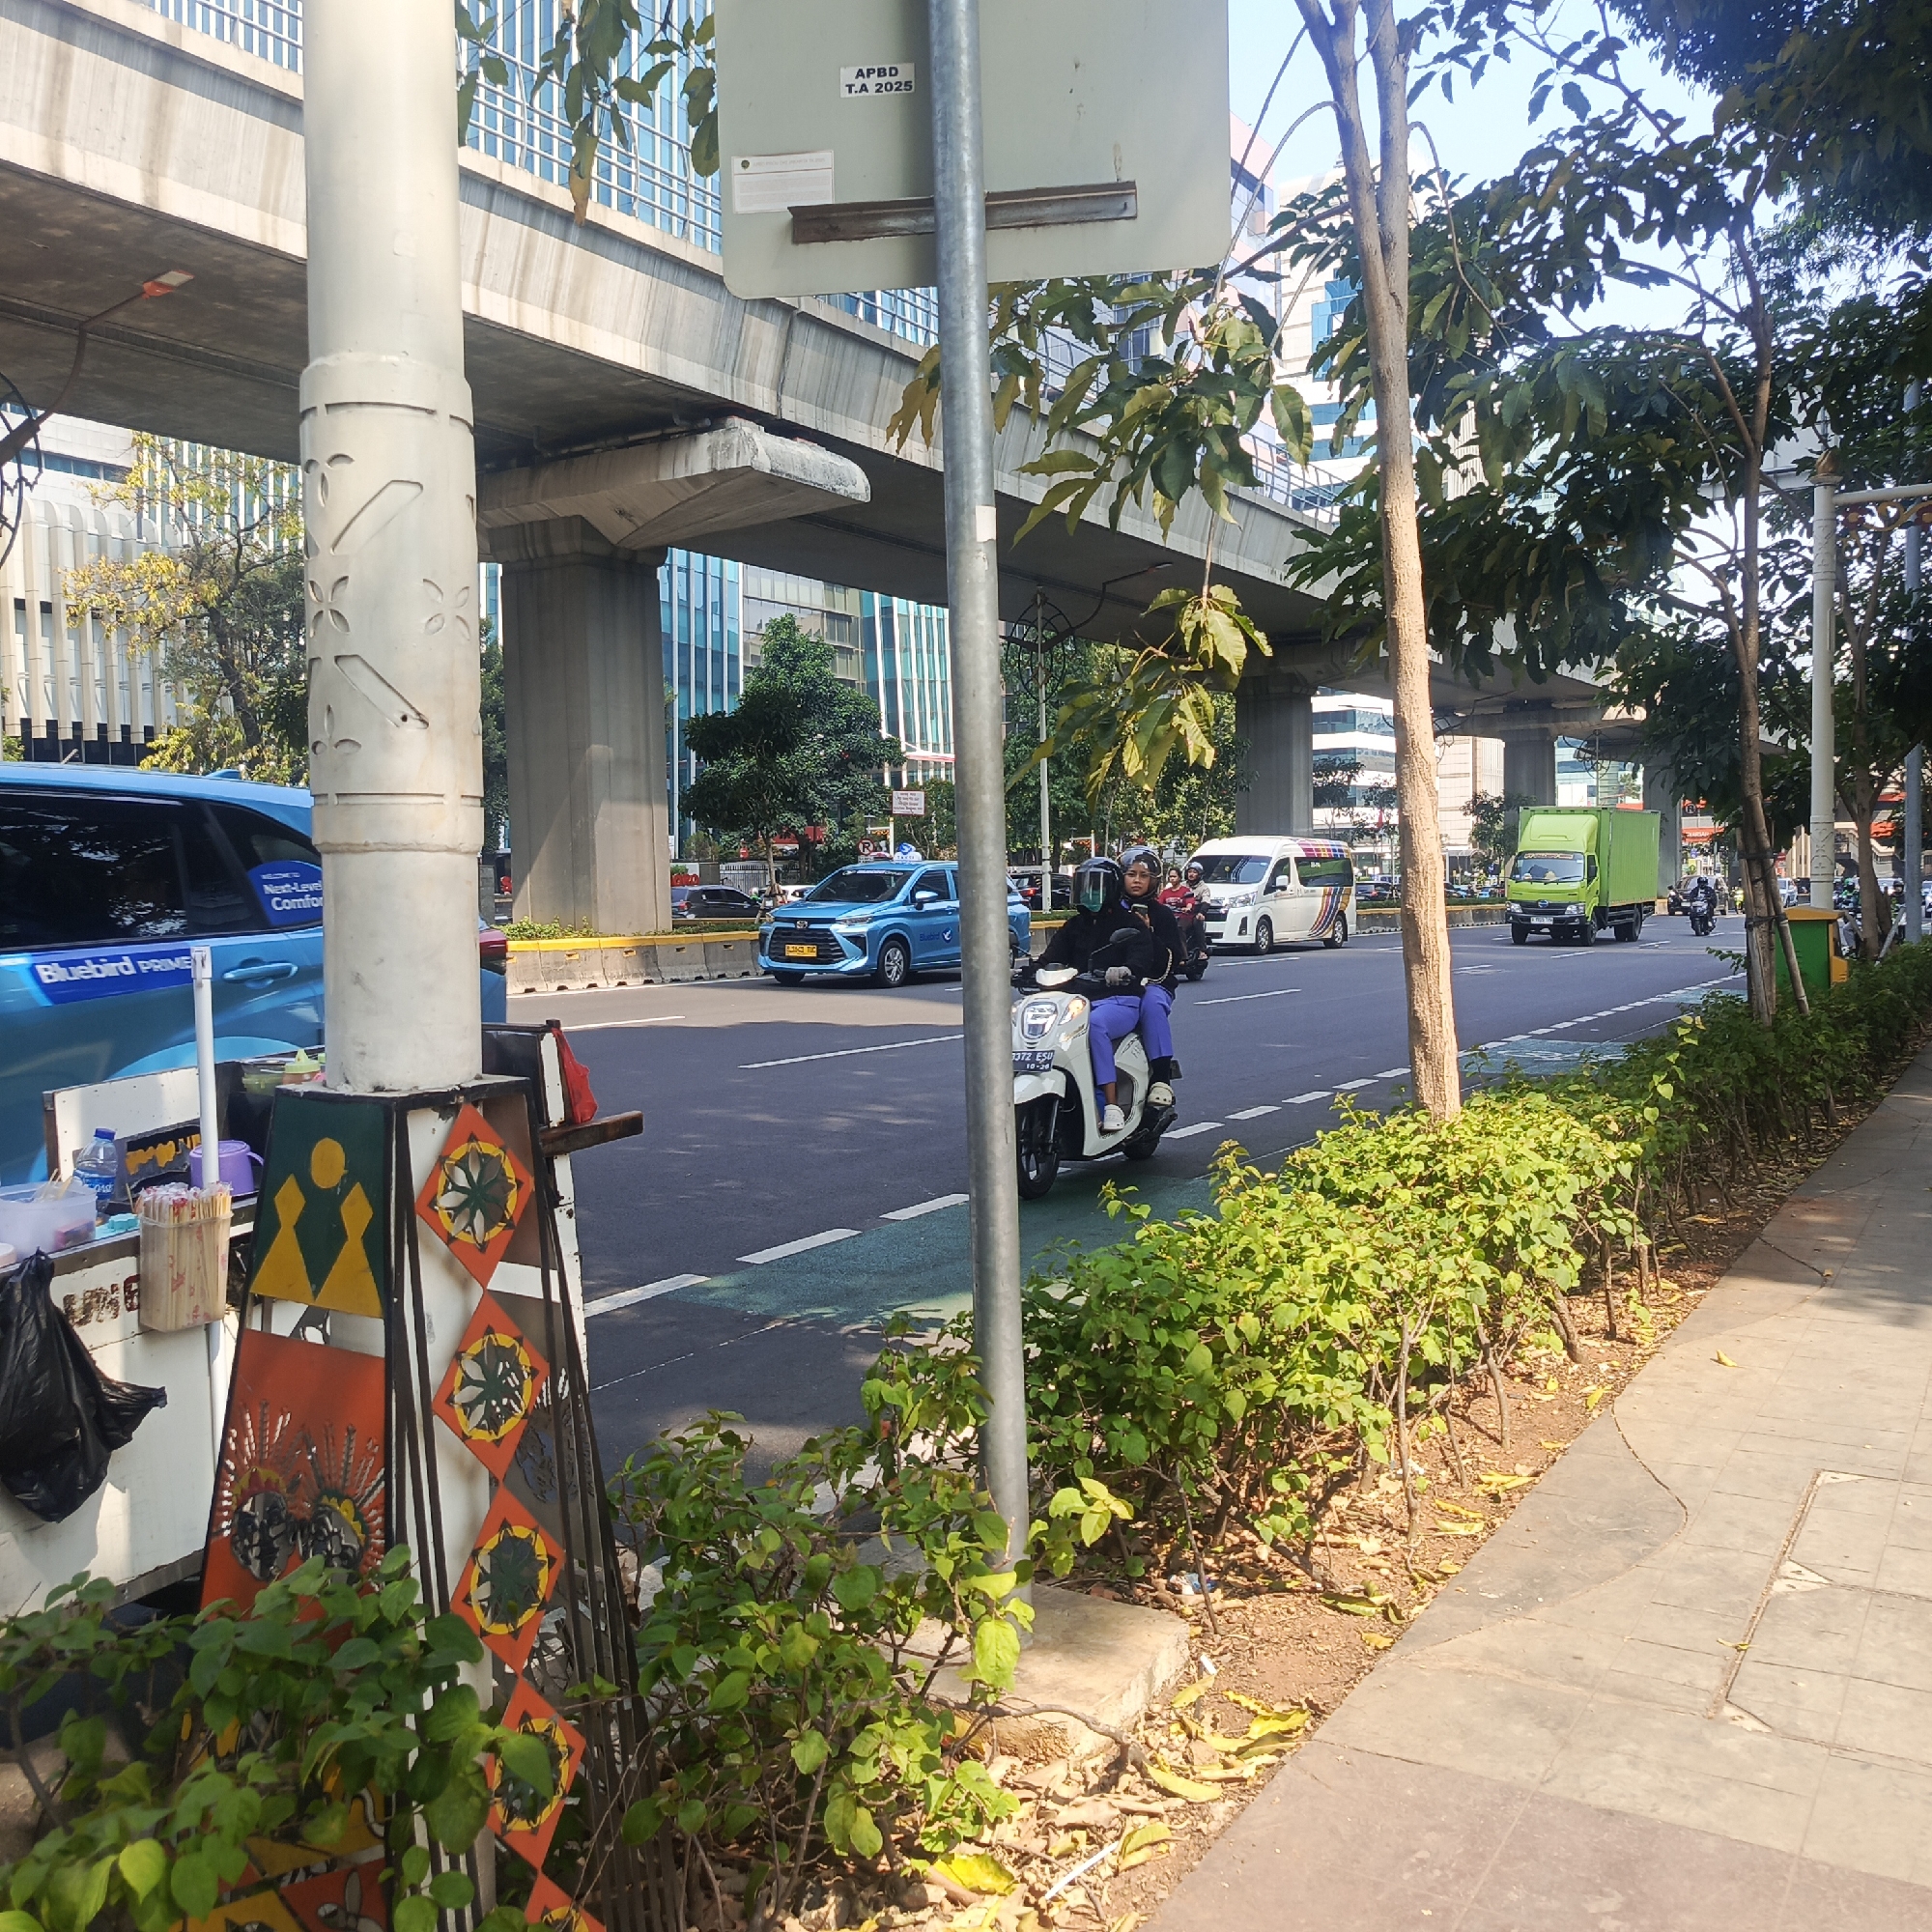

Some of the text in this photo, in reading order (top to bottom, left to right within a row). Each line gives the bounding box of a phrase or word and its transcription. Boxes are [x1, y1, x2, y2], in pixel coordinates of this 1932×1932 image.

[855, 67, 898, 79] APBD
[845, 81, 913, 95] T.A 2025
[36, 956, 192, 983] Bluebird PRIME
